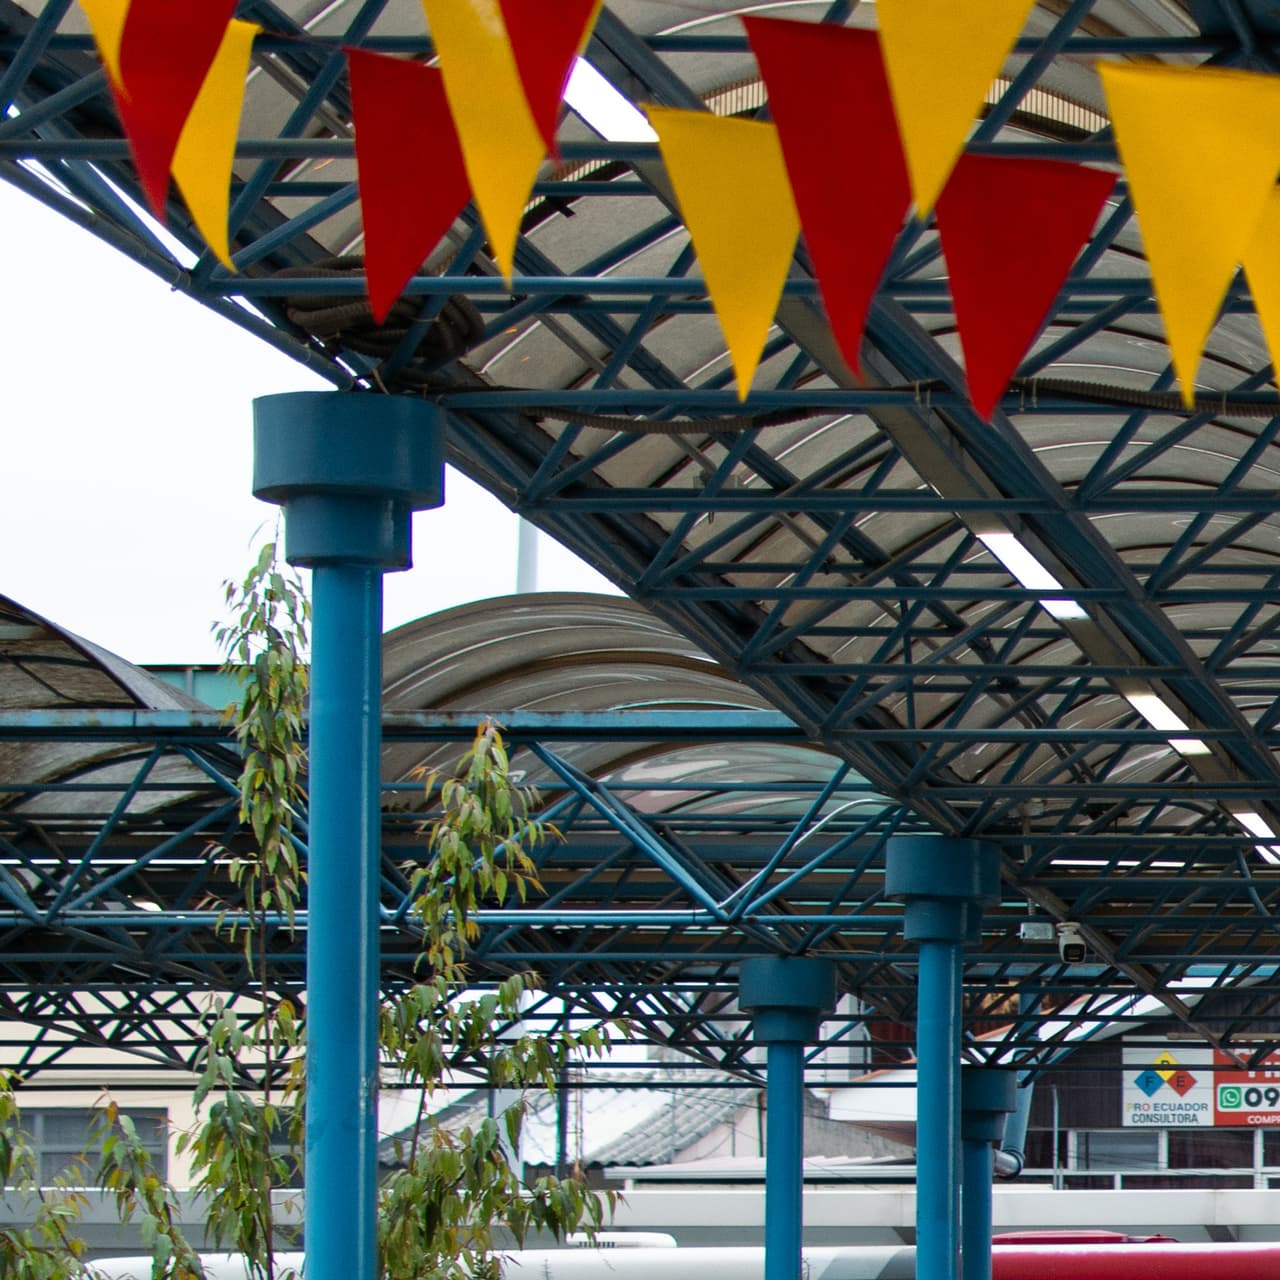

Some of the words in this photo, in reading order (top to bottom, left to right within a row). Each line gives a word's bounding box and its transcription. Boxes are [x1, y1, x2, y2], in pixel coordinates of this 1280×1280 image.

[1126, 1103, 1150, 1112] PRO
[1153, 1103, 1209, 1112] ECUADOR
[1132, 1113, 1199, 1124] CONSULTORA
